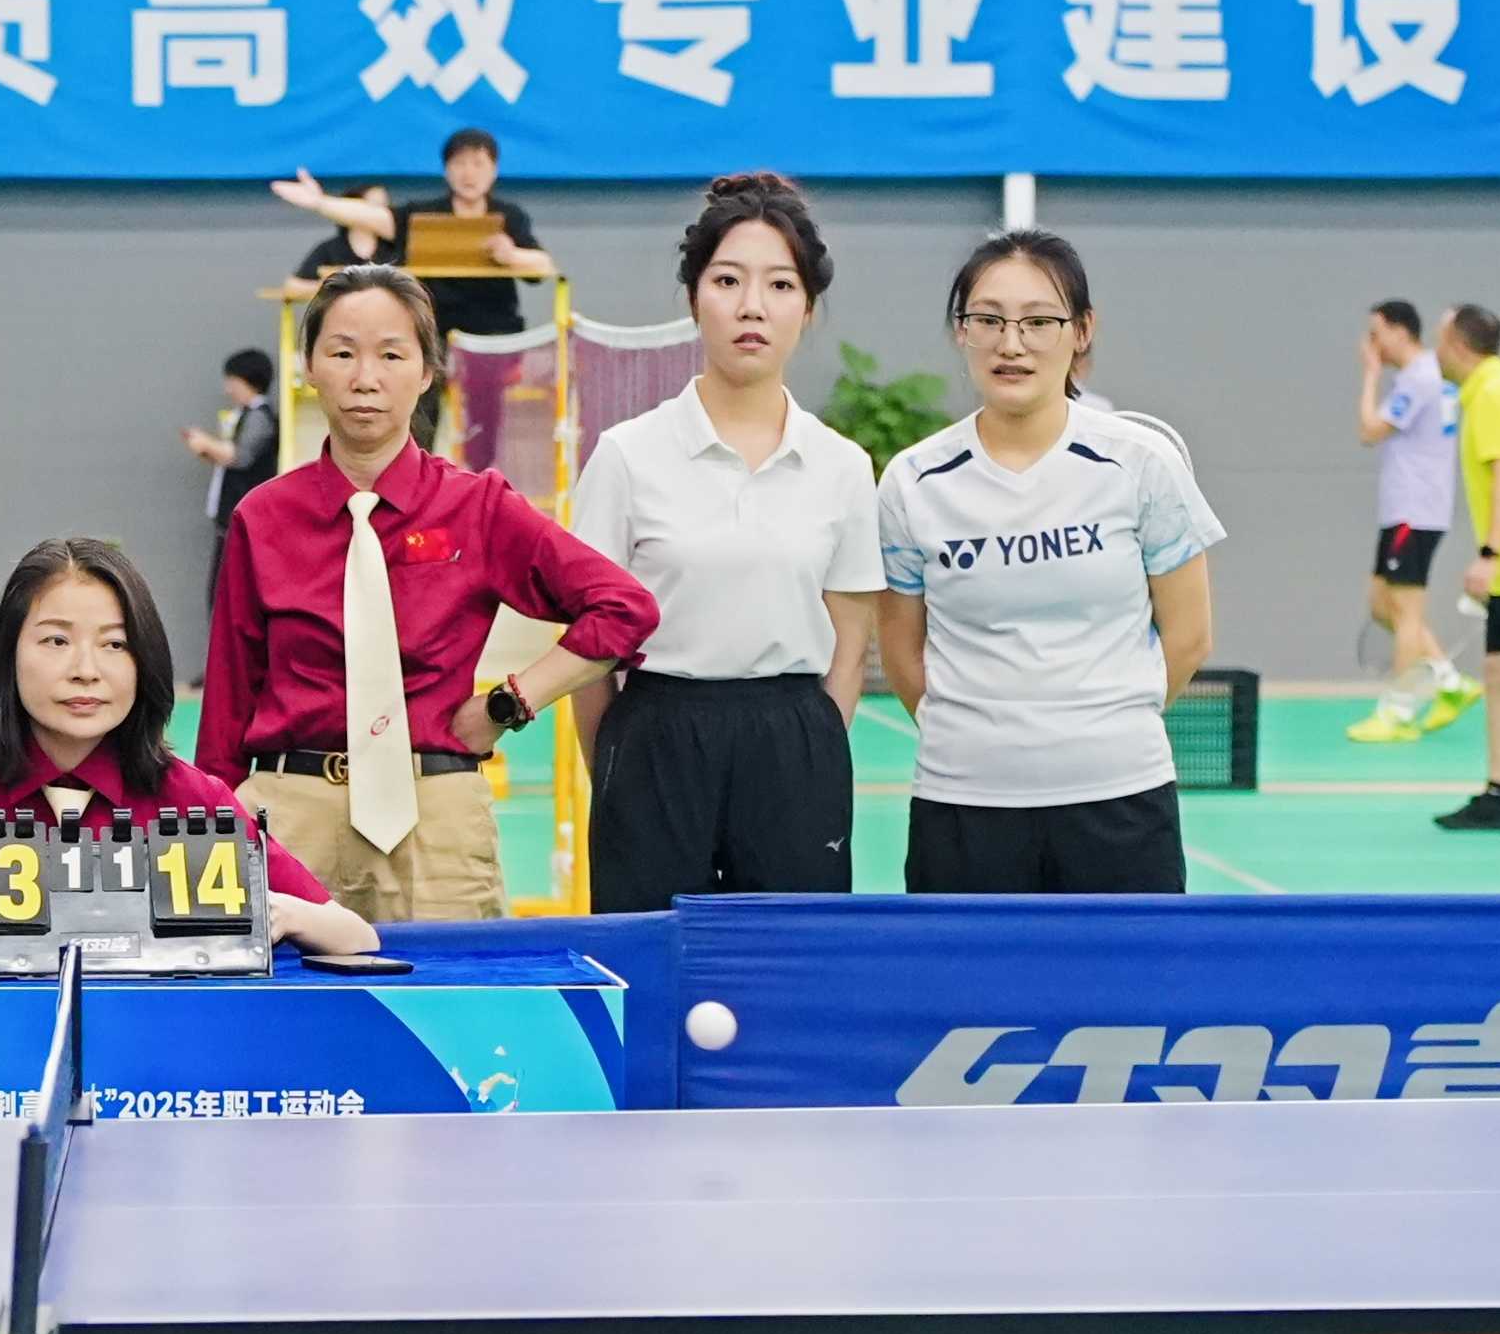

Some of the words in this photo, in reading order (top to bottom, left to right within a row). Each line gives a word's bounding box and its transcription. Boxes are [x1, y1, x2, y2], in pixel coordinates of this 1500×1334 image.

[996, 523, 1104, 566] YONEX
[61, 846, 82, 890] 1
[113, 846, 135, 889] 1
[157, 841, 246, 916] 14
